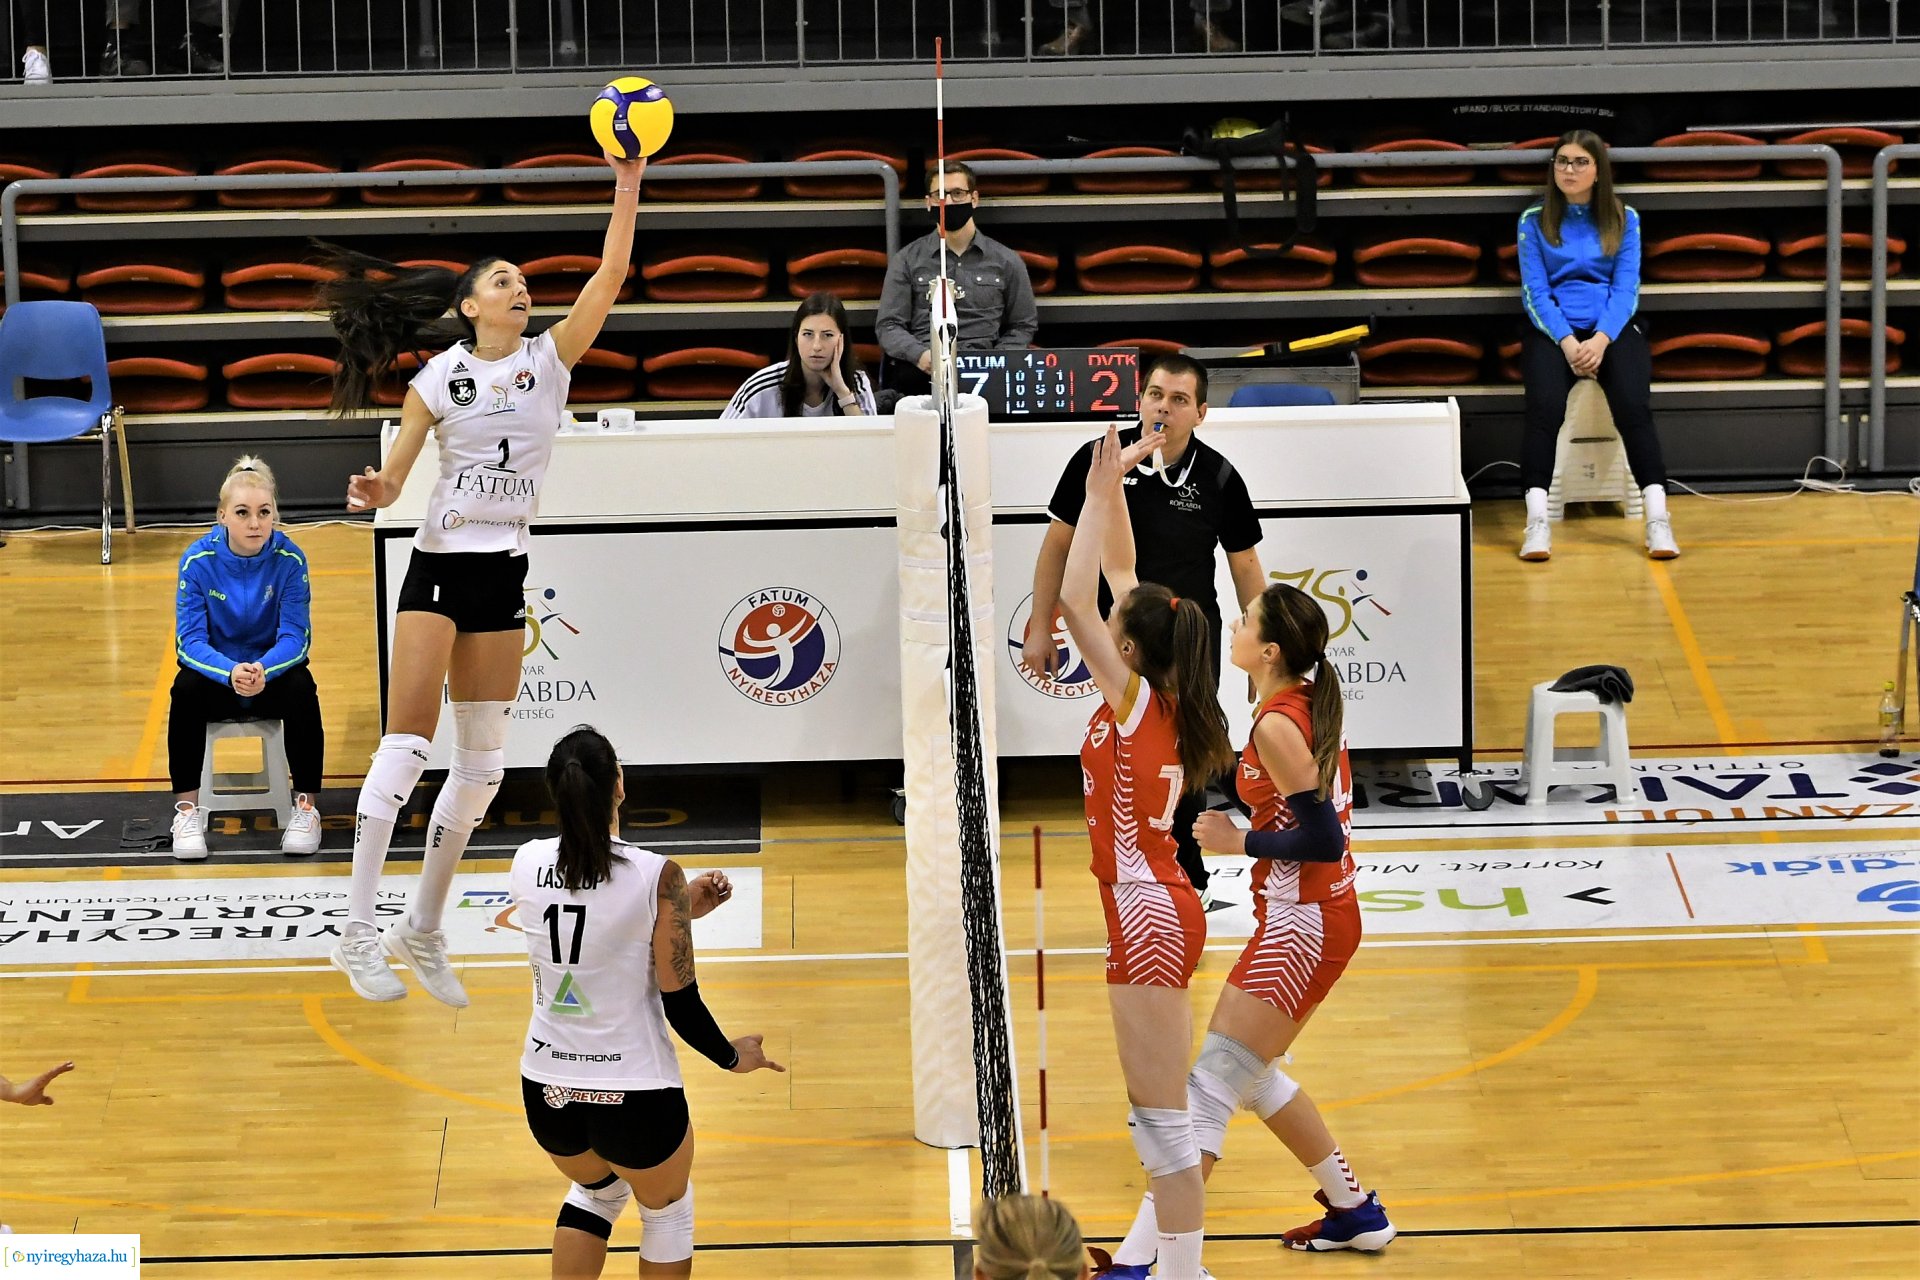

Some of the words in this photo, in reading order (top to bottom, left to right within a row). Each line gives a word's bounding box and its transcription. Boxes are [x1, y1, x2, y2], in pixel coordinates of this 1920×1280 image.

[1090, 370, 1120, 411] 2
[453, 471, 535, 497] FATUM
[747, 589, 810, 608] FATUM
[1440, 859, 1604, 873] Korrekt.
[25, 893, 228, 905] Sportcentrum
[542, 903, 587, 966] 17
[551, 1050, 622, 1063] BESTRONG
